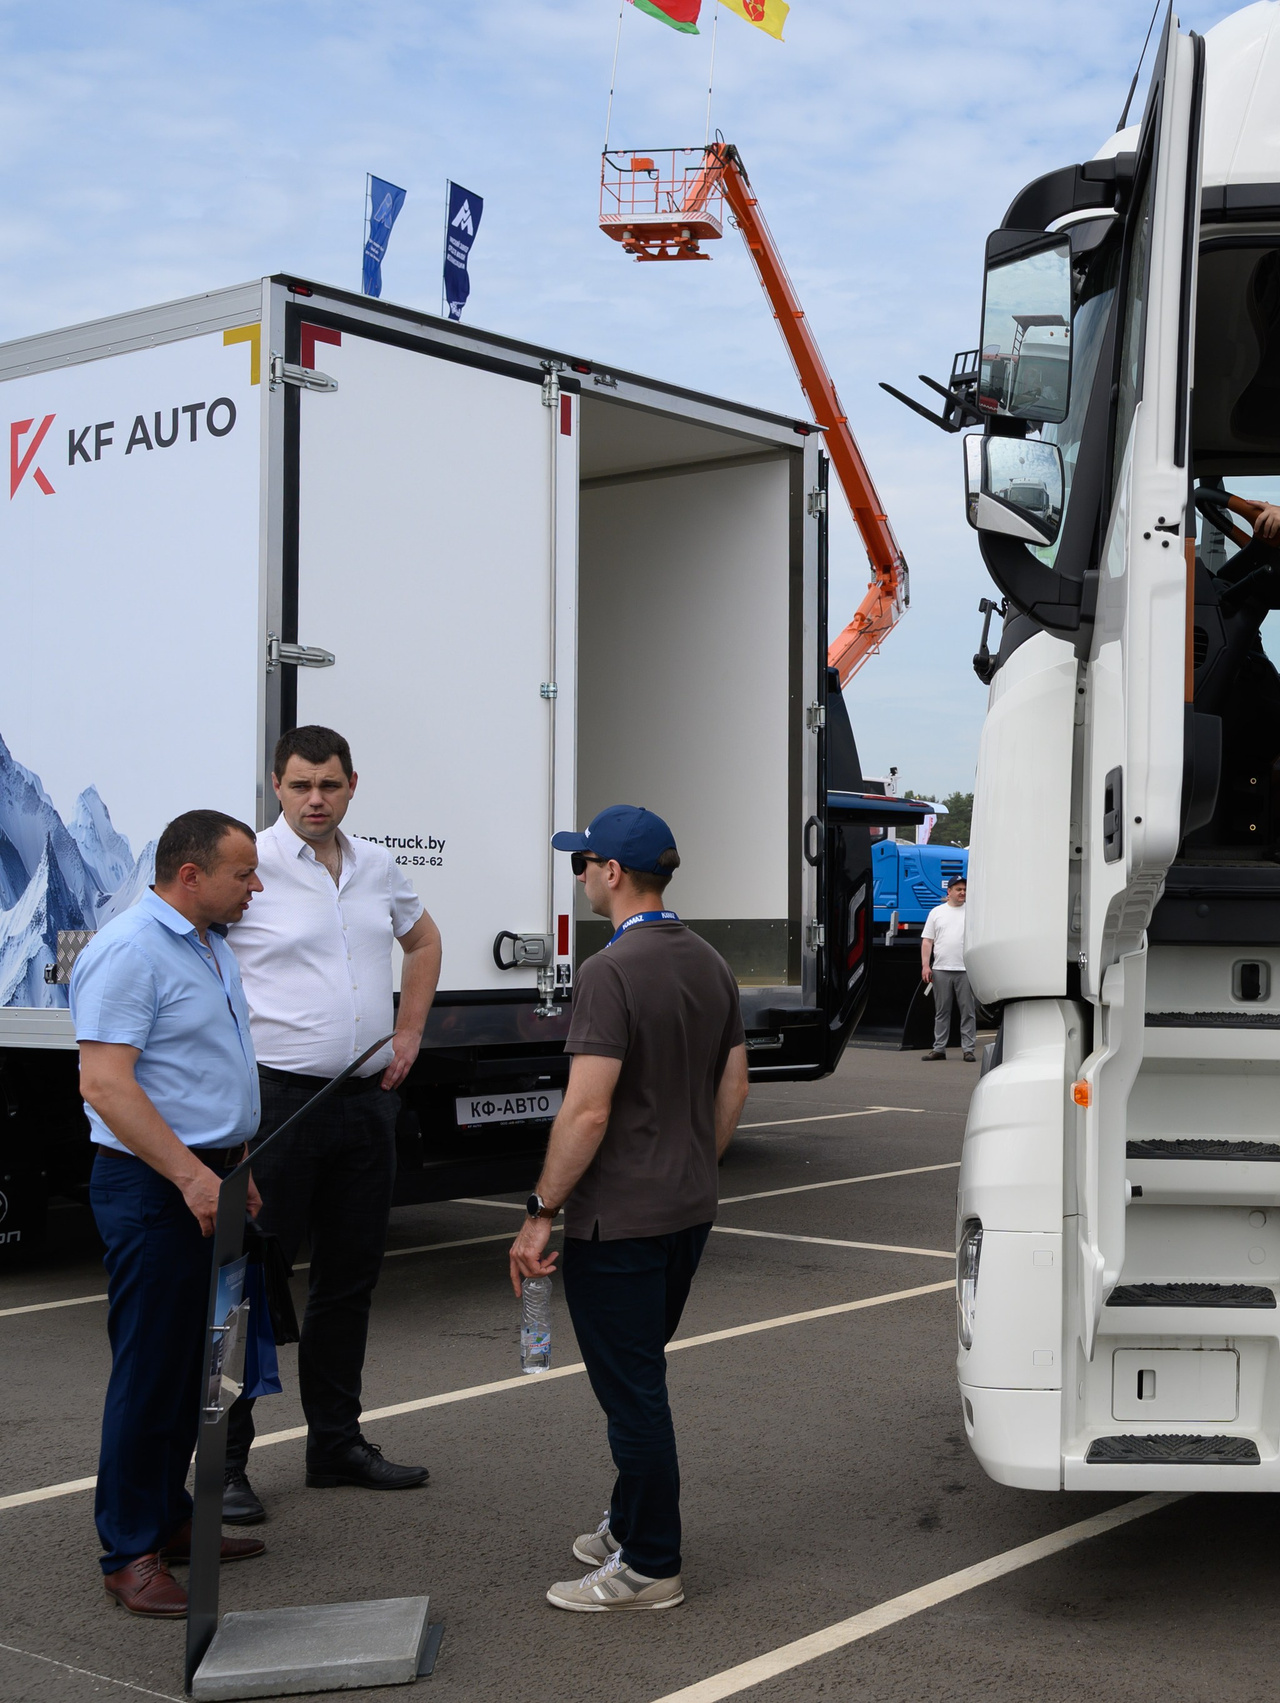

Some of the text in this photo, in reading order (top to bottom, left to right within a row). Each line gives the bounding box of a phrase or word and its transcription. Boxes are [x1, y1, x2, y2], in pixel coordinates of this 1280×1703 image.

[68, 396, 237, 466] KF AUTO
[395, 855, 443, 867] 42-52-62
[622, 914, 645, 930] KAMAZ
[471, 1096, 549, 1118] КФ-АВТО
